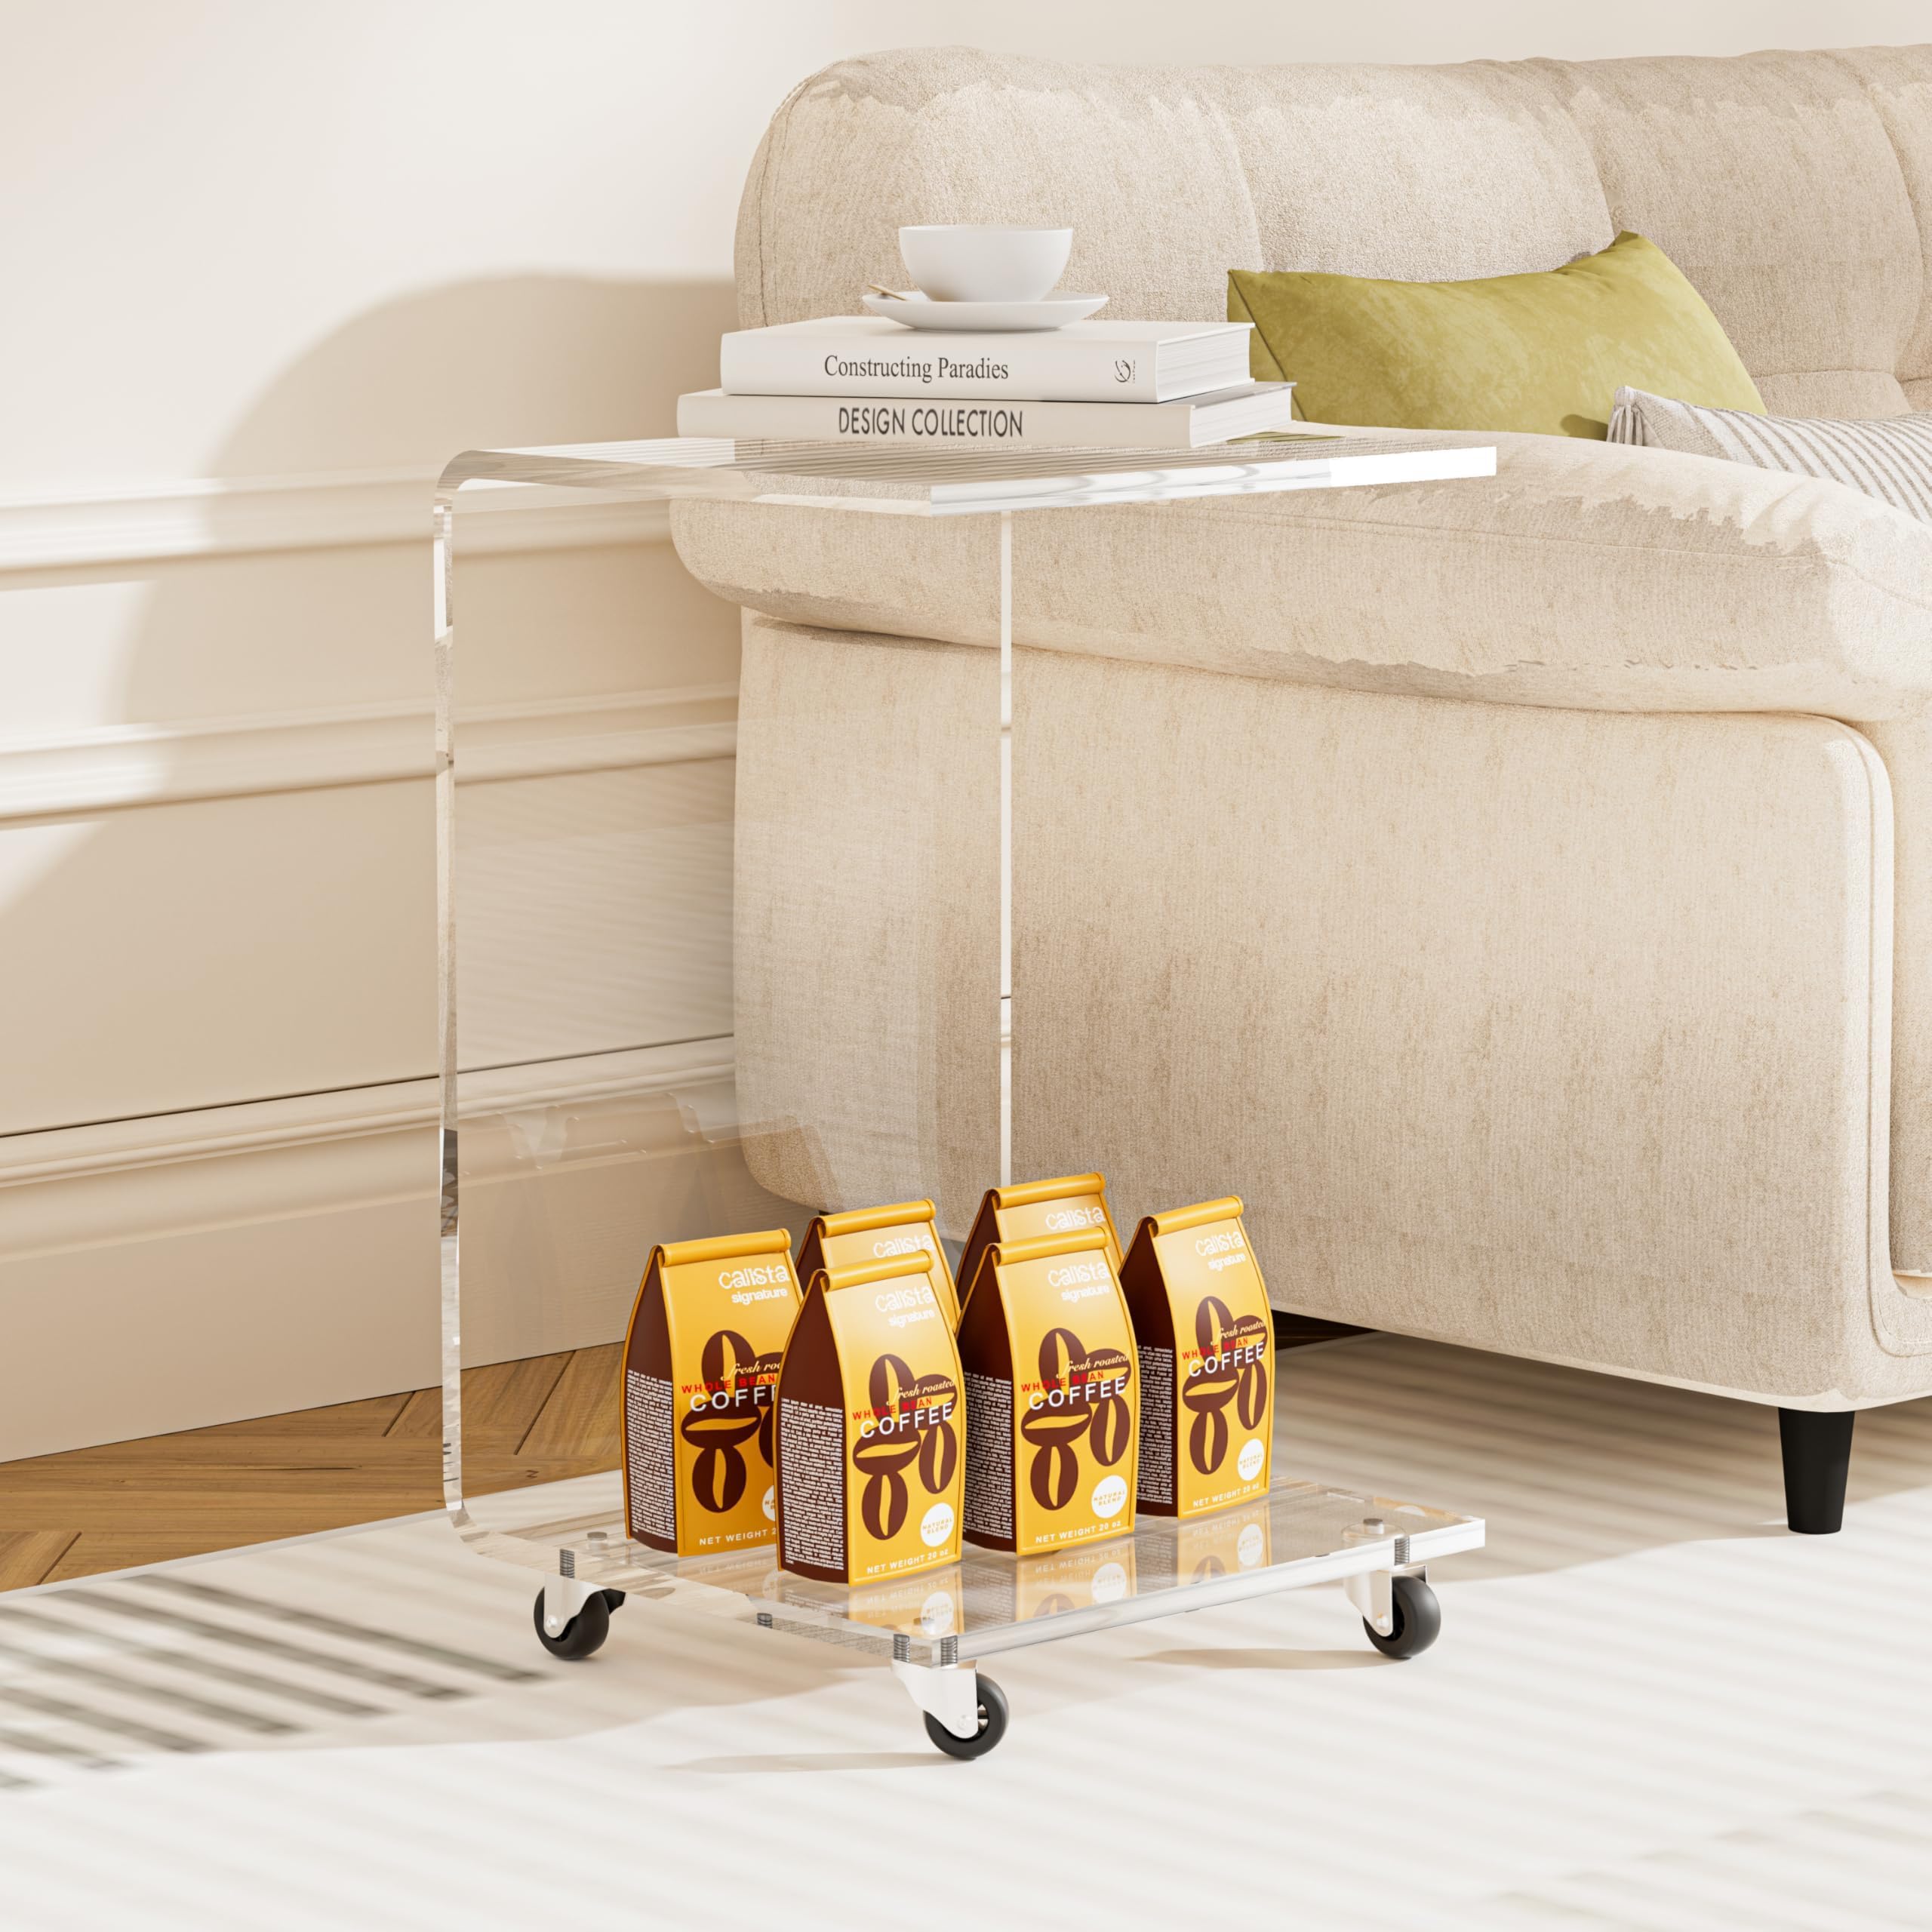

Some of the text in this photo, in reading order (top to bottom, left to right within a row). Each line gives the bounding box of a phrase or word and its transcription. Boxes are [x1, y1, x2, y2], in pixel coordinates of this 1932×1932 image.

[825, 355, 1009, 383] Constructing Paradies
[839, 408, 1023, 437] DESIGN COLLECTION
[1045, 1207, 1106, 1230] Calista
[1195, 1231, 1244, 1257] Calista
[718, 1265, 789, 1289] Calista
[1048, 1262, 1110, 1287] Calista
[731, 1287, 788, 1305] signature
[875, 1286, 935, 1312] Calista
[1211, 1316, 1267, 1345] fresh roasted
[721, 1361, 761, 1380] fresh
[1056, 1349, 1131, 1379] fresh roasted
[1188, 1341, 1264, 1377] COFFEE
[681, 1373, 776, 1394] WHOLE BEAN
[886, 1374, 956, 1406] fresh roasted
[1021, 1377, 1066, 1392] WHOLE
[1029, 1377, 1126, 1411] COFFEE
[690, 1384, 777, 1412] COFF
[853, 1404, 896, 1420] WHOLE
[860, 1401, 953, 1438] COFFEE
[1192, 1497, 1208, 1508] NET
[1212, 1488, 1241, 1503] WEIGHT
[700, 1536, 721, 1546] NET
[725, 1529, 768, 1543] WEIGHT
[1035, 1533, 1056, 1543] NET
[1059, 1525, 1097, 1540] WEIGHT
[1099, 1522, 1109, 1531] 20
[866, 1564, 887, 1574] NET
[889, 1555, 925, 1571] WEIGHT
[928, 1551, 937, 1561] 20
